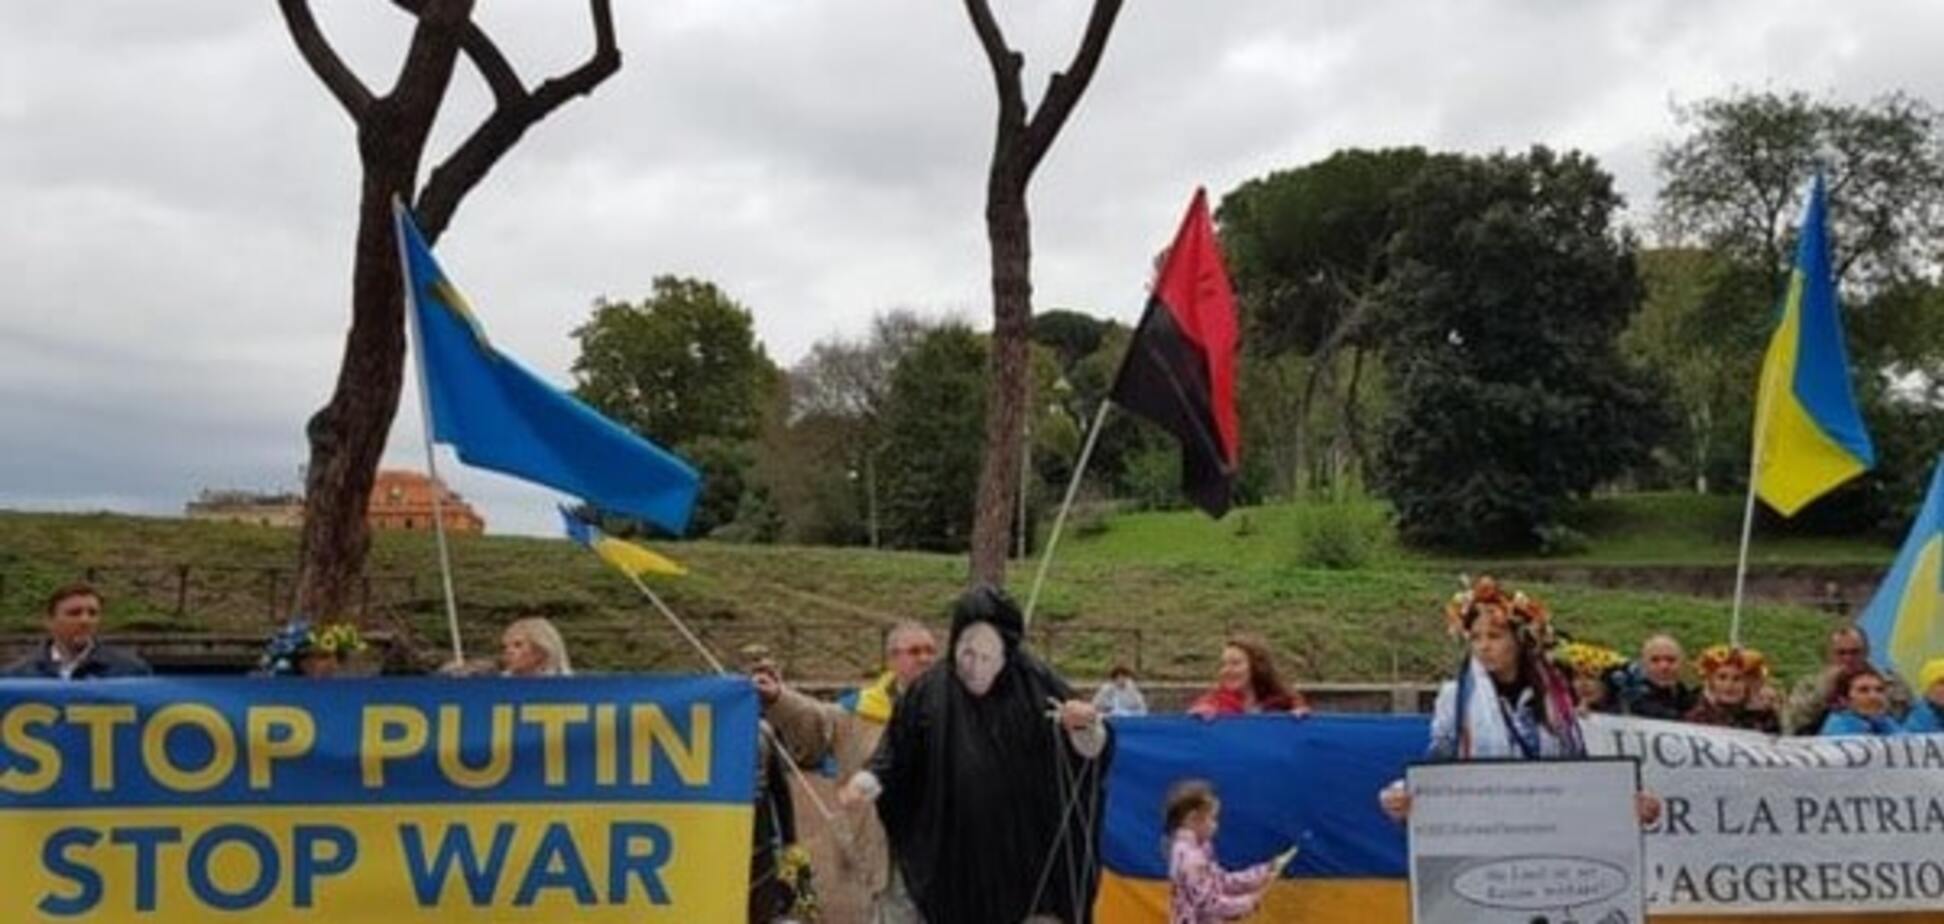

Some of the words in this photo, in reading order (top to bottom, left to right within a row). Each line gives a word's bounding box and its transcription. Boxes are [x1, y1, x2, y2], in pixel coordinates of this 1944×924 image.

[0, 703, 316, 793] STOP
[361, 704, 711, 788] PUTIN
[1716, 796, 1781, 834] LA
[1794, 796, 1944, 834] PATRIA
[37, 823, 357, 917] STOP
[398, 822, 673, 906] WAR
